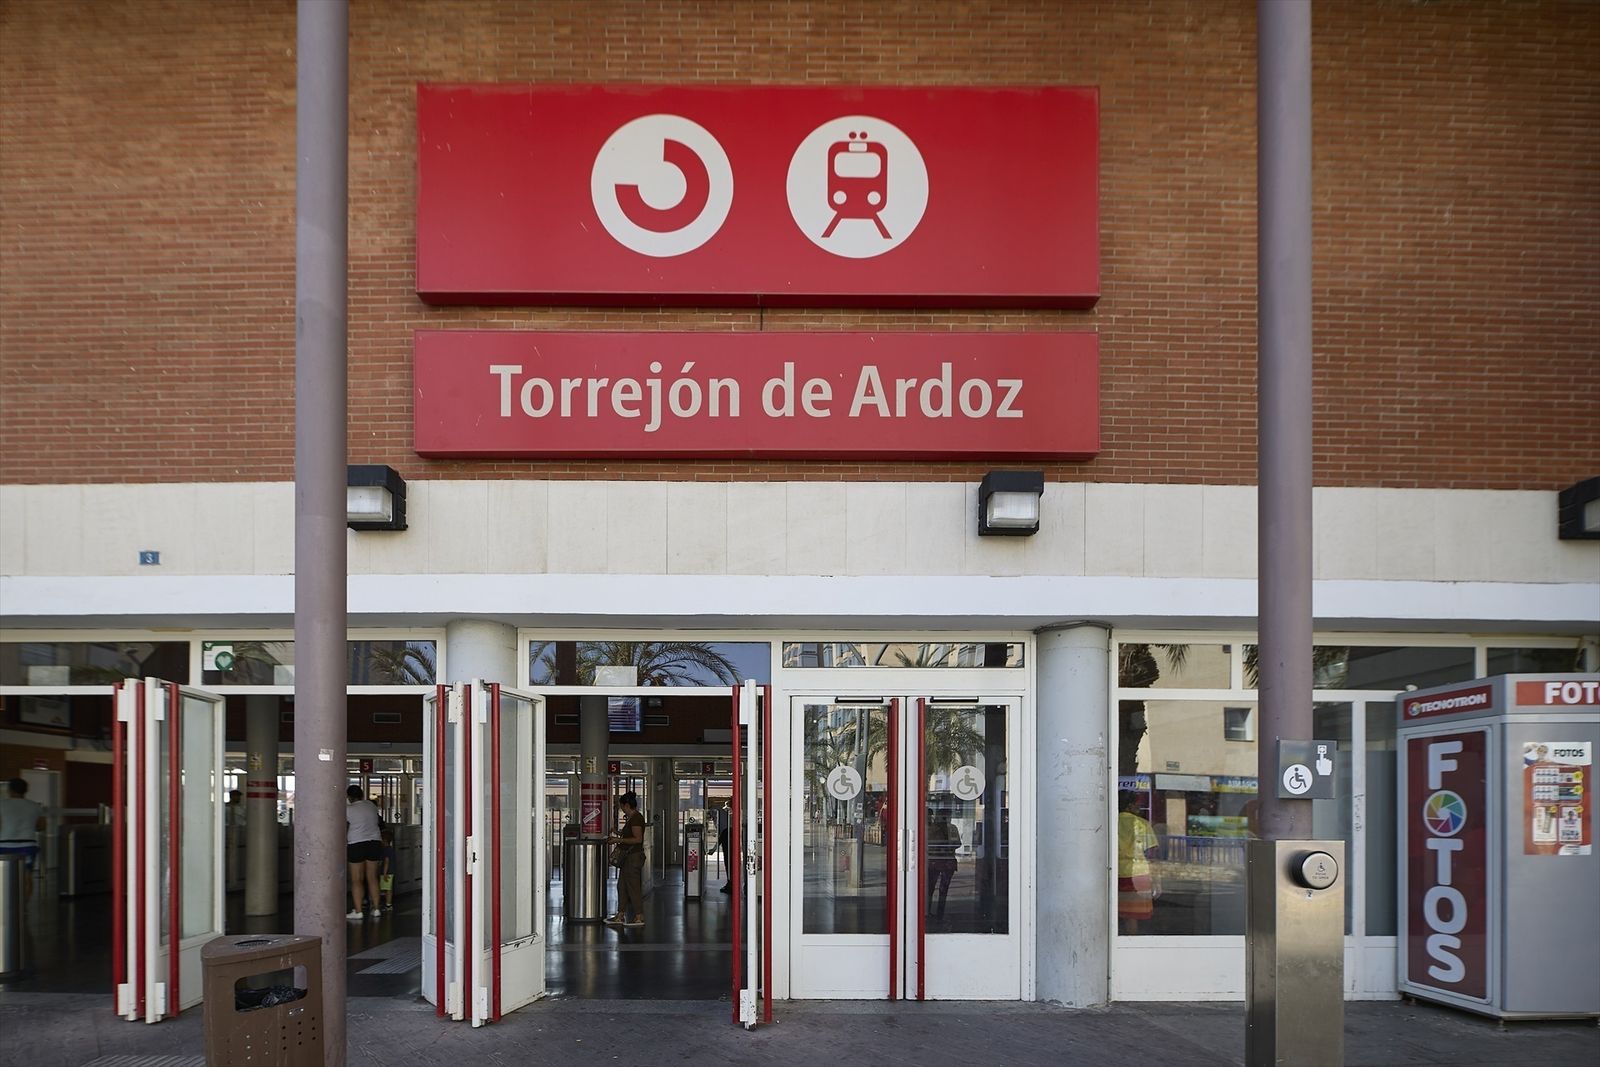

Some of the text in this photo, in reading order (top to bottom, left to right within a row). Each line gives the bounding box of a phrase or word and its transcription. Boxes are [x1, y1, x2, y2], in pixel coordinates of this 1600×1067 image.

[489, 360, 1024, 432] Torrejón de Ardoz
[1544, 681, 1600, 704] FOT
[1420, 693, 1487, 712] TECNOTRON
[1553, 748, 1585, 758] FOTOS
[363, 761, 369, 770] 5
[611, 763, 617, 772] 5
[706, 764, 711, 773] 5
[1423, 740, 1468, 983] FOTOS
